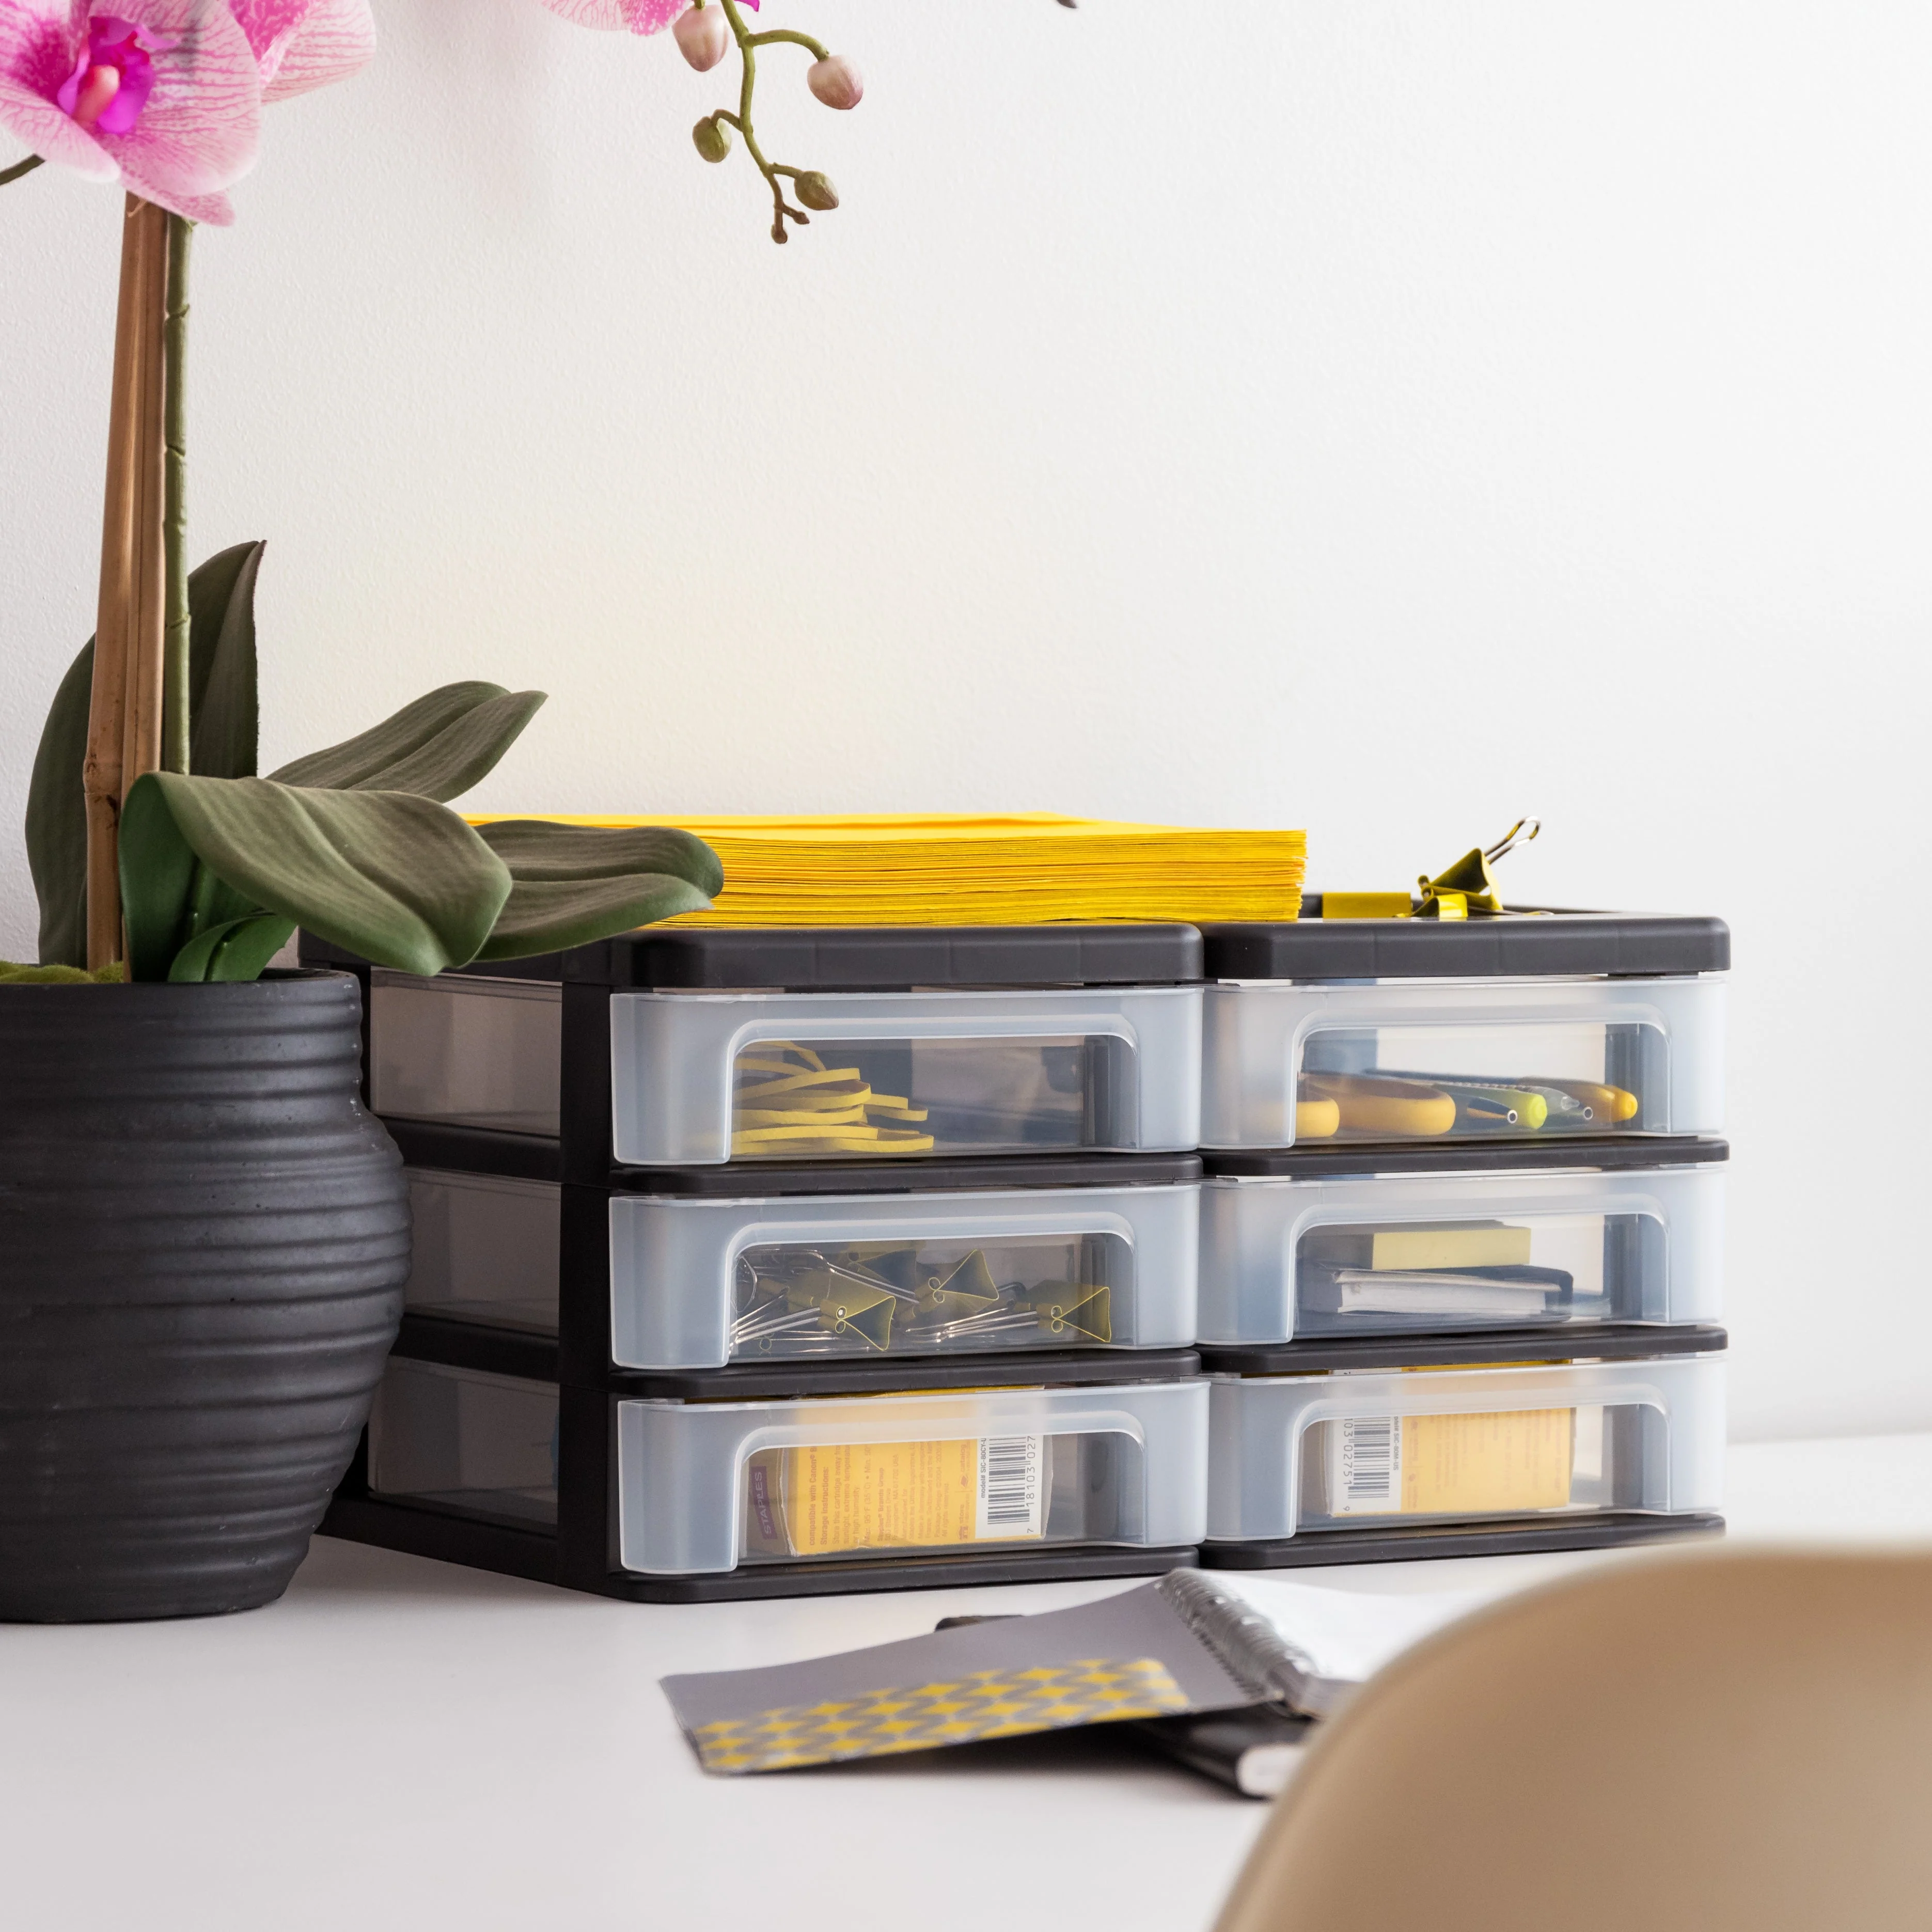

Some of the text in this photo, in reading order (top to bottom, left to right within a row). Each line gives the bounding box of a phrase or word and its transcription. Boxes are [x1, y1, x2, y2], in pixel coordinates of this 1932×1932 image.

[1343, 1445, 1353, 1485] 02751
[755, 1471, 772, 1535] STAPLES
[1026, 1467, 1035, 1507] 18103
[808, 1504, 816, 1546] compatible
[820, 1516, 829, 1545] Storage
[852, 1519, 860, 1534] high
